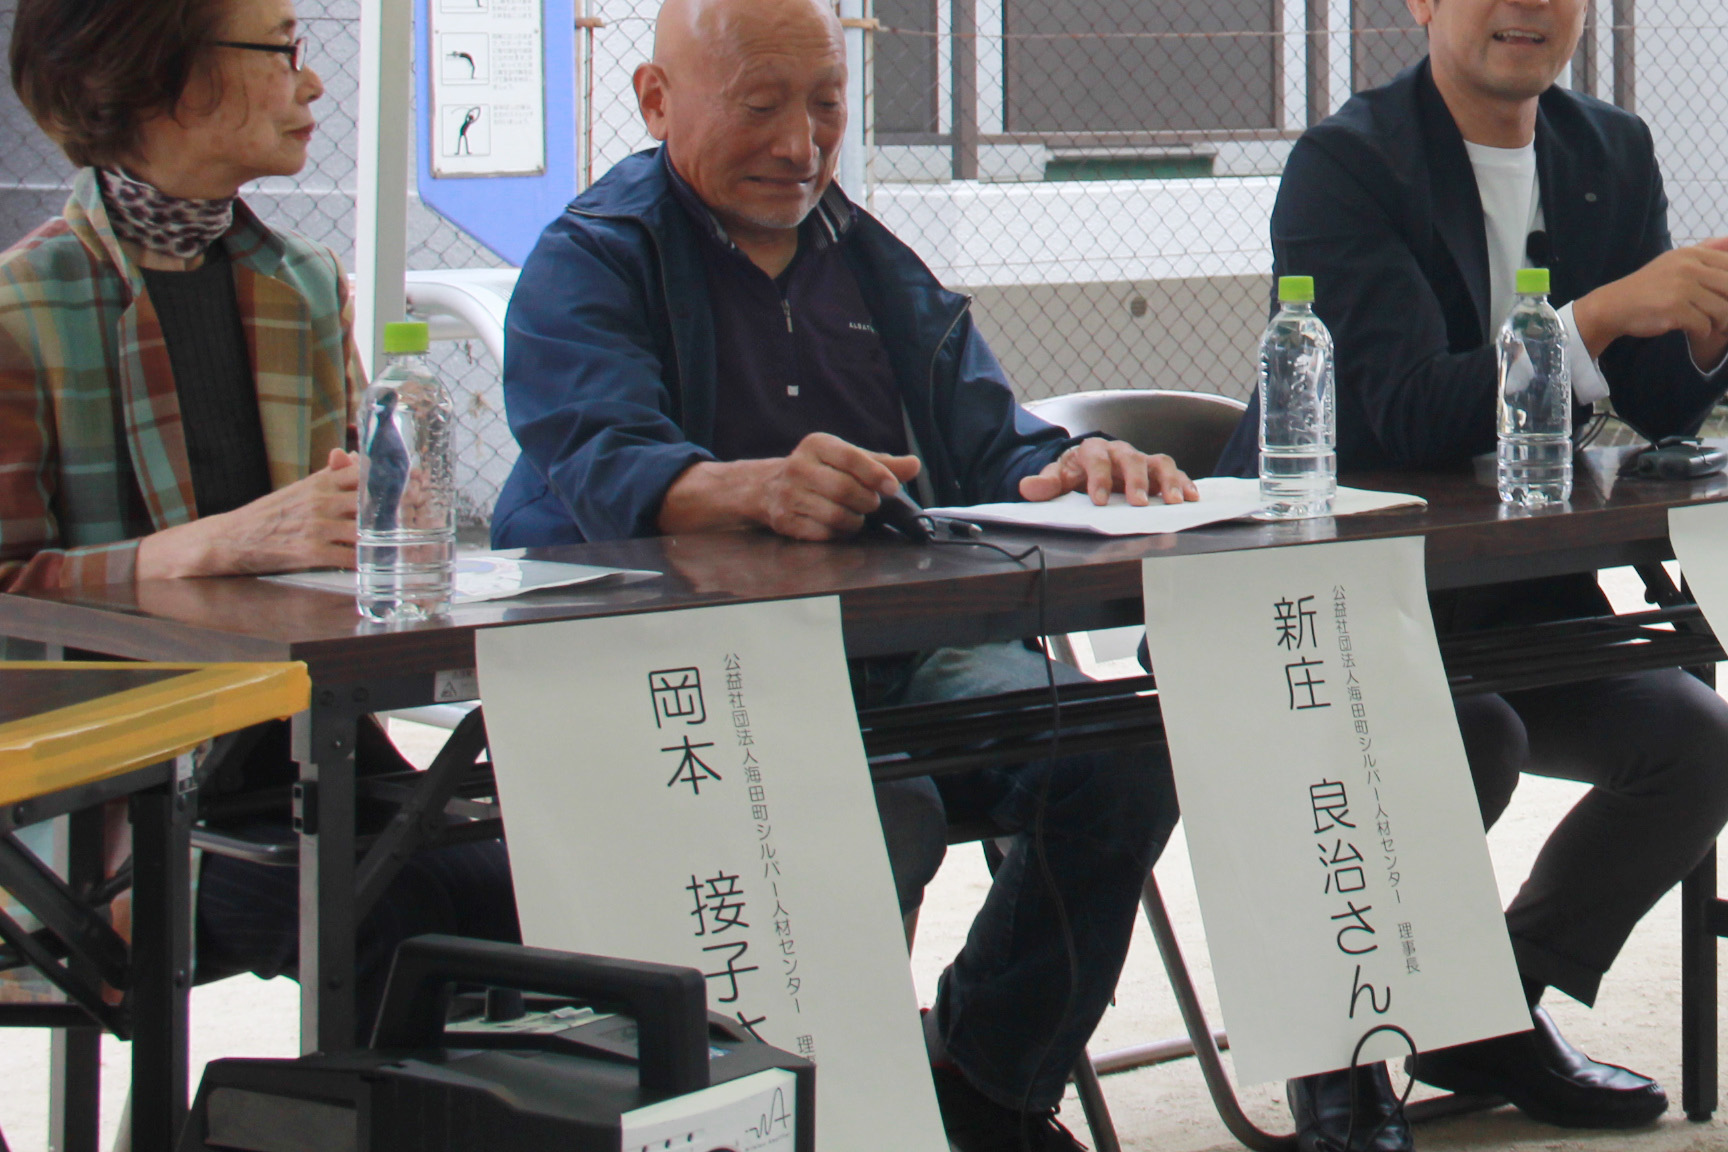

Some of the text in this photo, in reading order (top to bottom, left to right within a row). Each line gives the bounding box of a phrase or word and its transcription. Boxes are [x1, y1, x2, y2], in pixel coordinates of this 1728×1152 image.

[648, 666, 722, 796] 岡本
[723, 652, 802, 1014] 公益社団法人海田町シルバー人材センター
[1273, 594, 1392, 1020] 新庄 良治さん
[1331, 584, 1422, 976] 公益社団法人海田町シルバー人材センター 理事長
